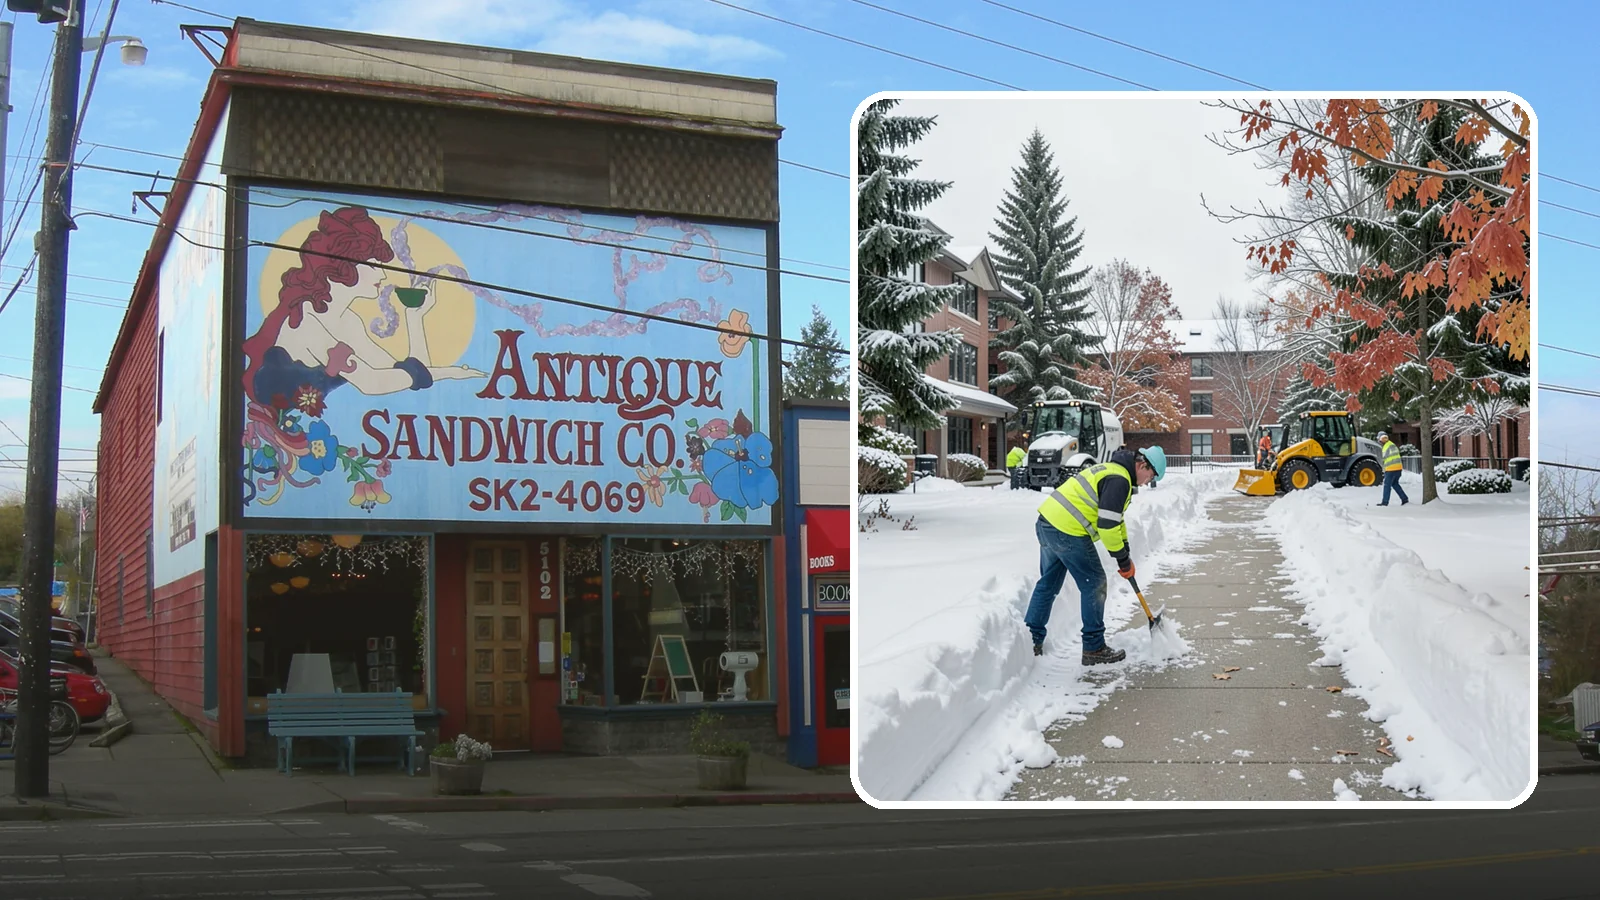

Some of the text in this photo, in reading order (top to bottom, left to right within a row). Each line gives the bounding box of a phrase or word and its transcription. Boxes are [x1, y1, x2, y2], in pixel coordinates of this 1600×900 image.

[475, 328, 723, 420] ANTIQUE
[361, 408, 685, 469] SANDWICH CO.
[468, 477, 646, 513] SK2-4069
[540, 541, 551, 599] 5102
[809, 555, 834, 568] BOOKS
